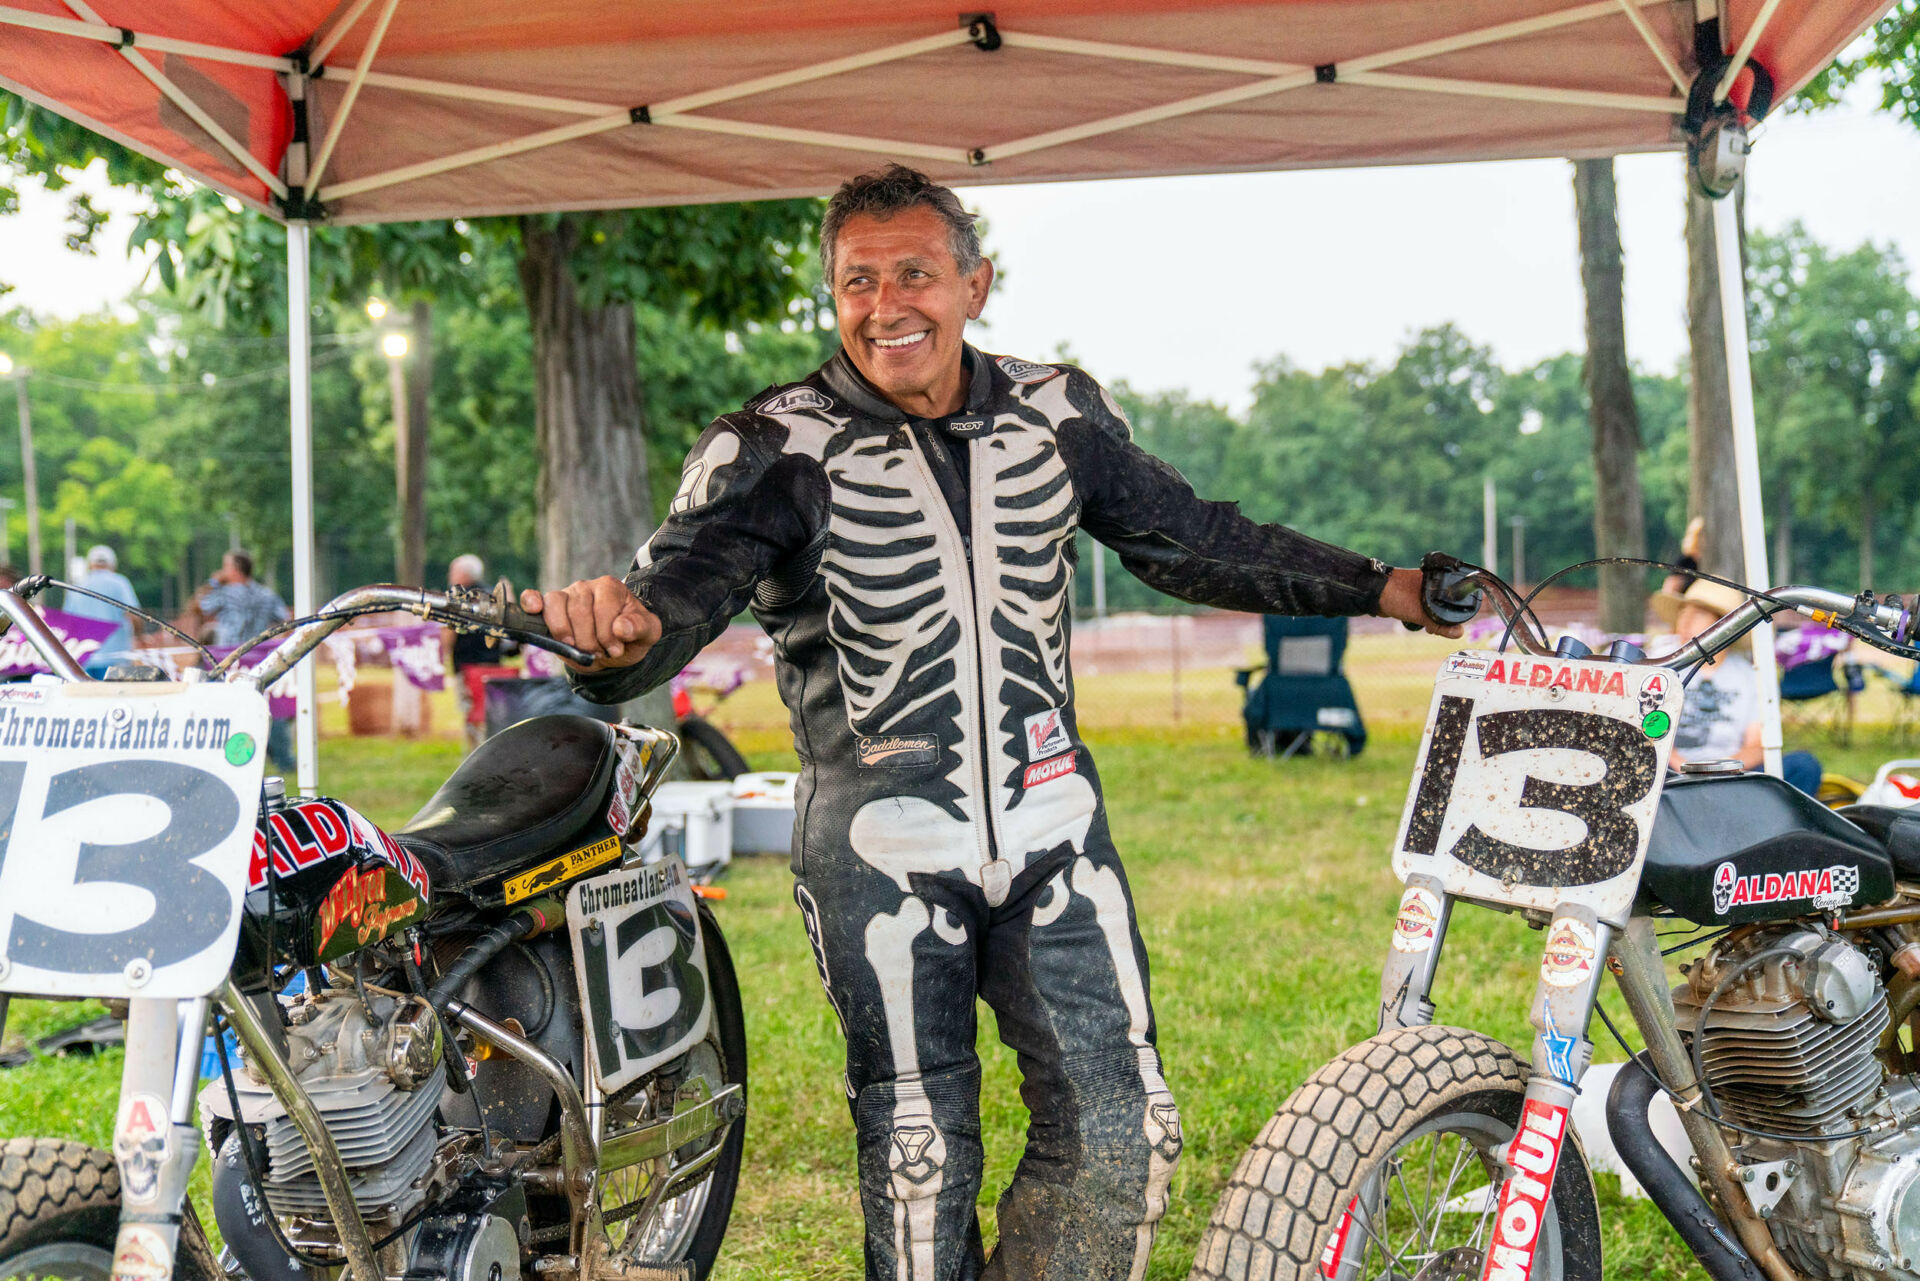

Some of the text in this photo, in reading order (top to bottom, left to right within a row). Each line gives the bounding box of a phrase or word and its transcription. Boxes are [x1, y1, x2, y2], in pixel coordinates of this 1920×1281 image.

[951, 421, 984, 431] PILOT
[1484, 659, 1625, 697] ALDANA
[1646, 676, 1662, 692] A
[860, 737, 936, 757] Saddlemen
[1027, 755, 1073, 785] MOTUL
[1403, 694, 1657, 888] 13
[0, 759, 240, 975] 3
[246, 800, 430, 904] ALDANA
[570, 838, 618, 866] PANTHER
[1731, 870, 1833, 904] ALDANA
[580, 900, 706, 1079] 13
[126, 1101, 156, 1133] A
